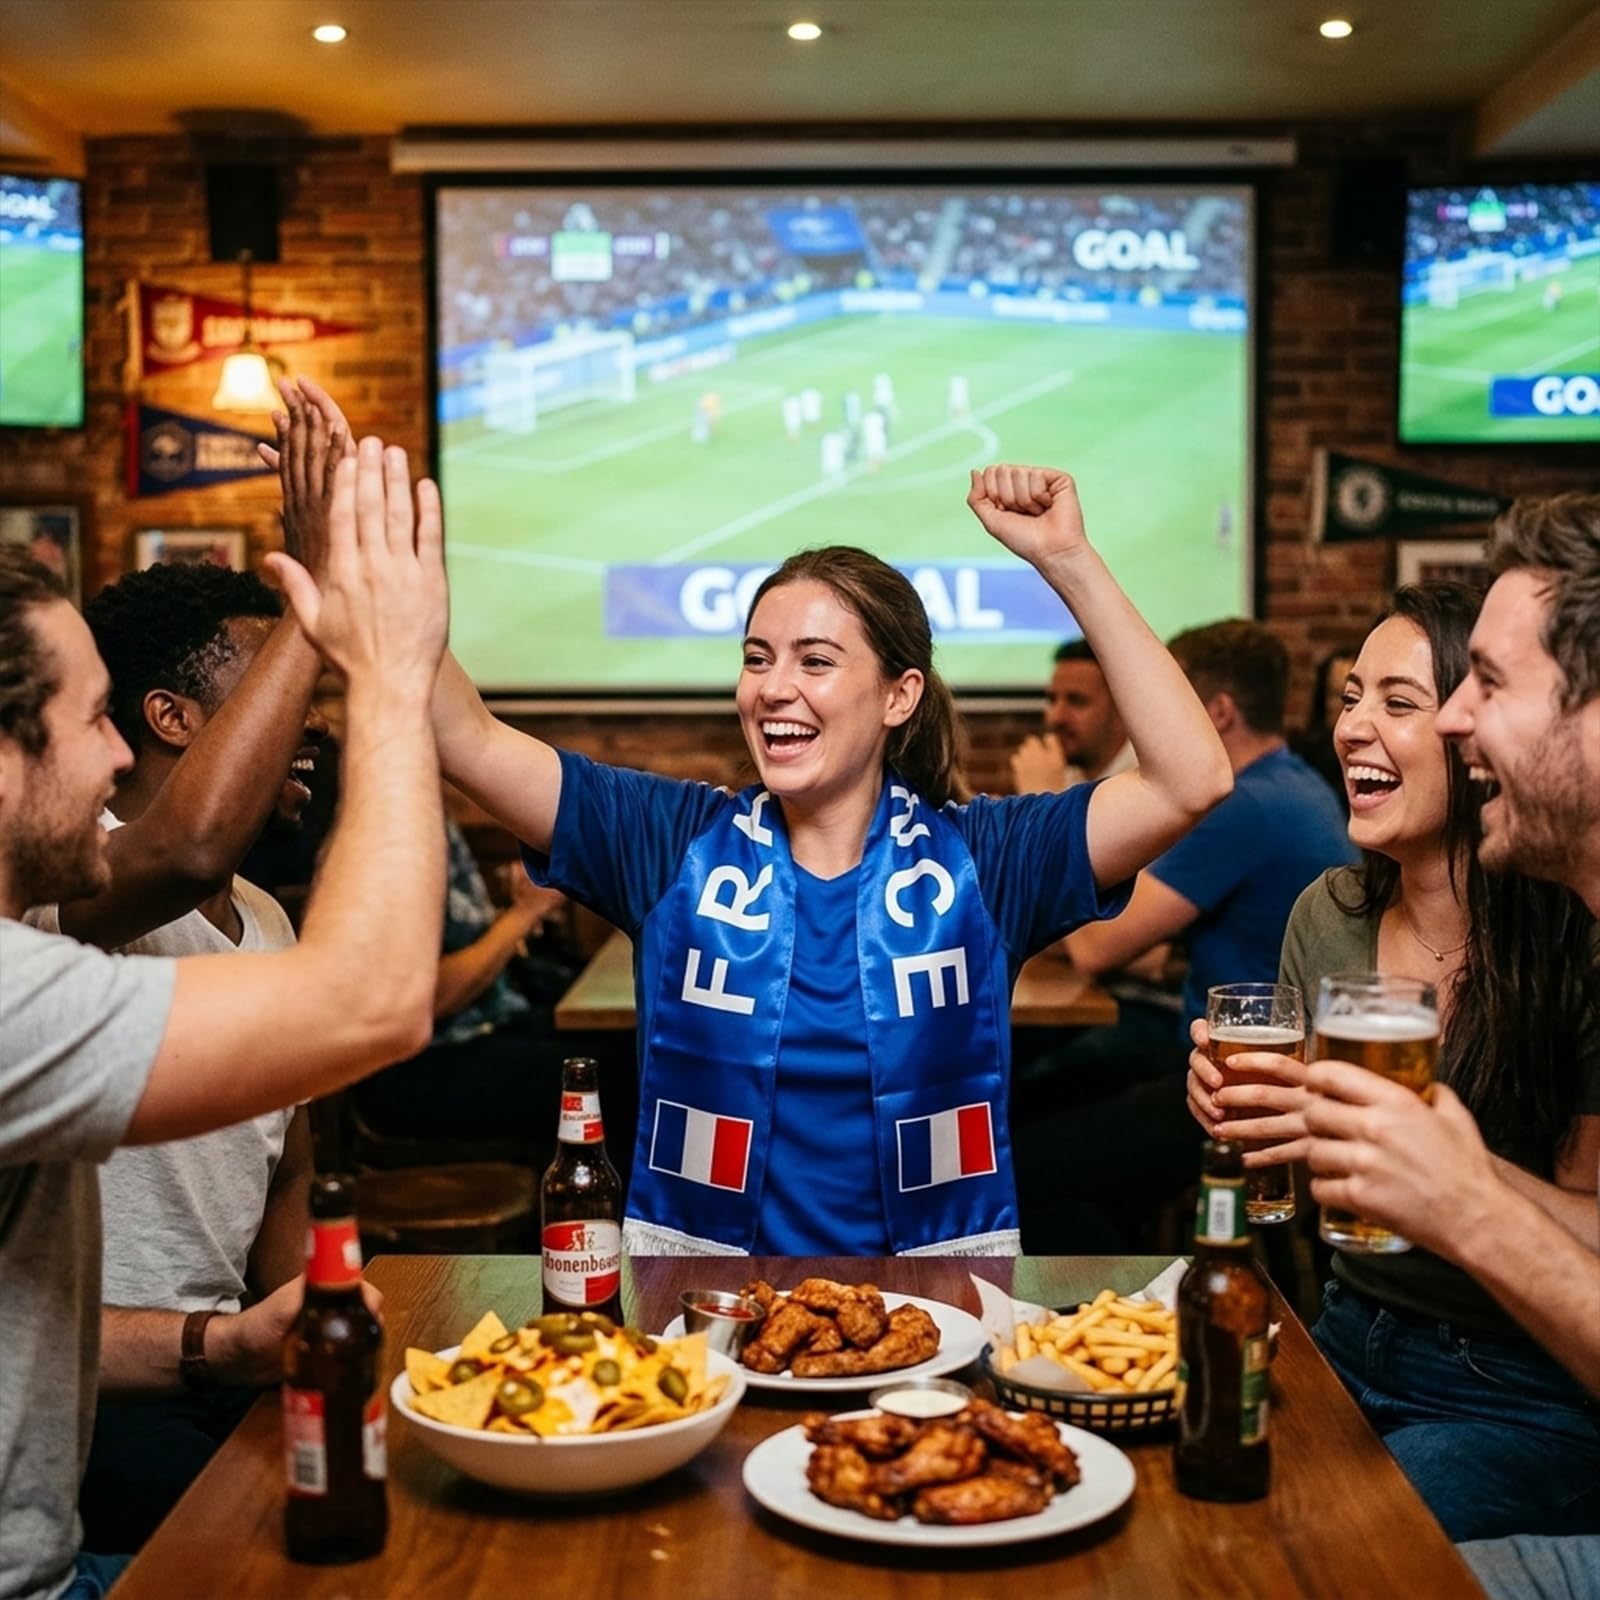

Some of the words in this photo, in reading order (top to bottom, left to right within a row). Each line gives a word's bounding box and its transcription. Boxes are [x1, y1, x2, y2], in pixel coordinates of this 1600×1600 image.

[1073, 229, 1199, 271] GOAL
[1532, 375, 1600, 415] GO
[681, 791, 773, 1016] FRA
